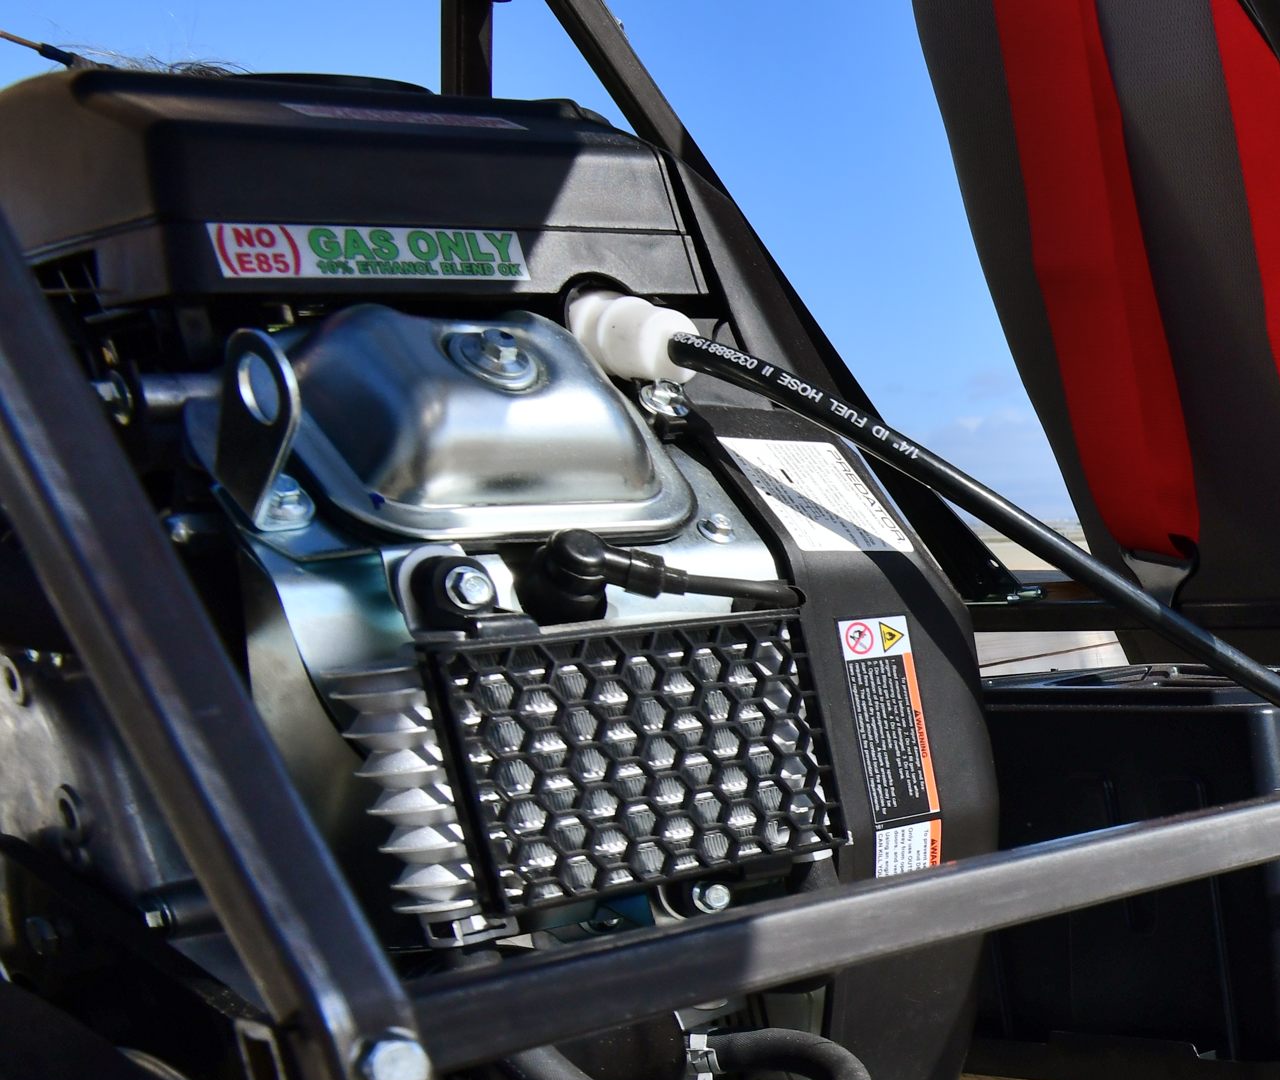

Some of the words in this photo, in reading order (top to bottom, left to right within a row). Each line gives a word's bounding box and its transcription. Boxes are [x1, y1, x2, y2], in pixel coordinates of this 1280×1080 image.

[231, 227, 276, 248] NO
[307, 227, 400, 261] GAS
[407, 229, 513, 263] ONLY
[235, 252, 290, 273] E85
[316, 260, 354, 274] 10%
[355, 260, 439, 275] ETHANOL
[440, 262, 495, 276] BLEND
[497, 263, 523, 276] OK
[776, 372, 824, 404] HOSE
[829, 398, 868, 427] FUEL
[872, 425, 890, 441] ID
[827, 449, 905, 541] PREDATOR
[914, 717, 928, 758] WARNING
